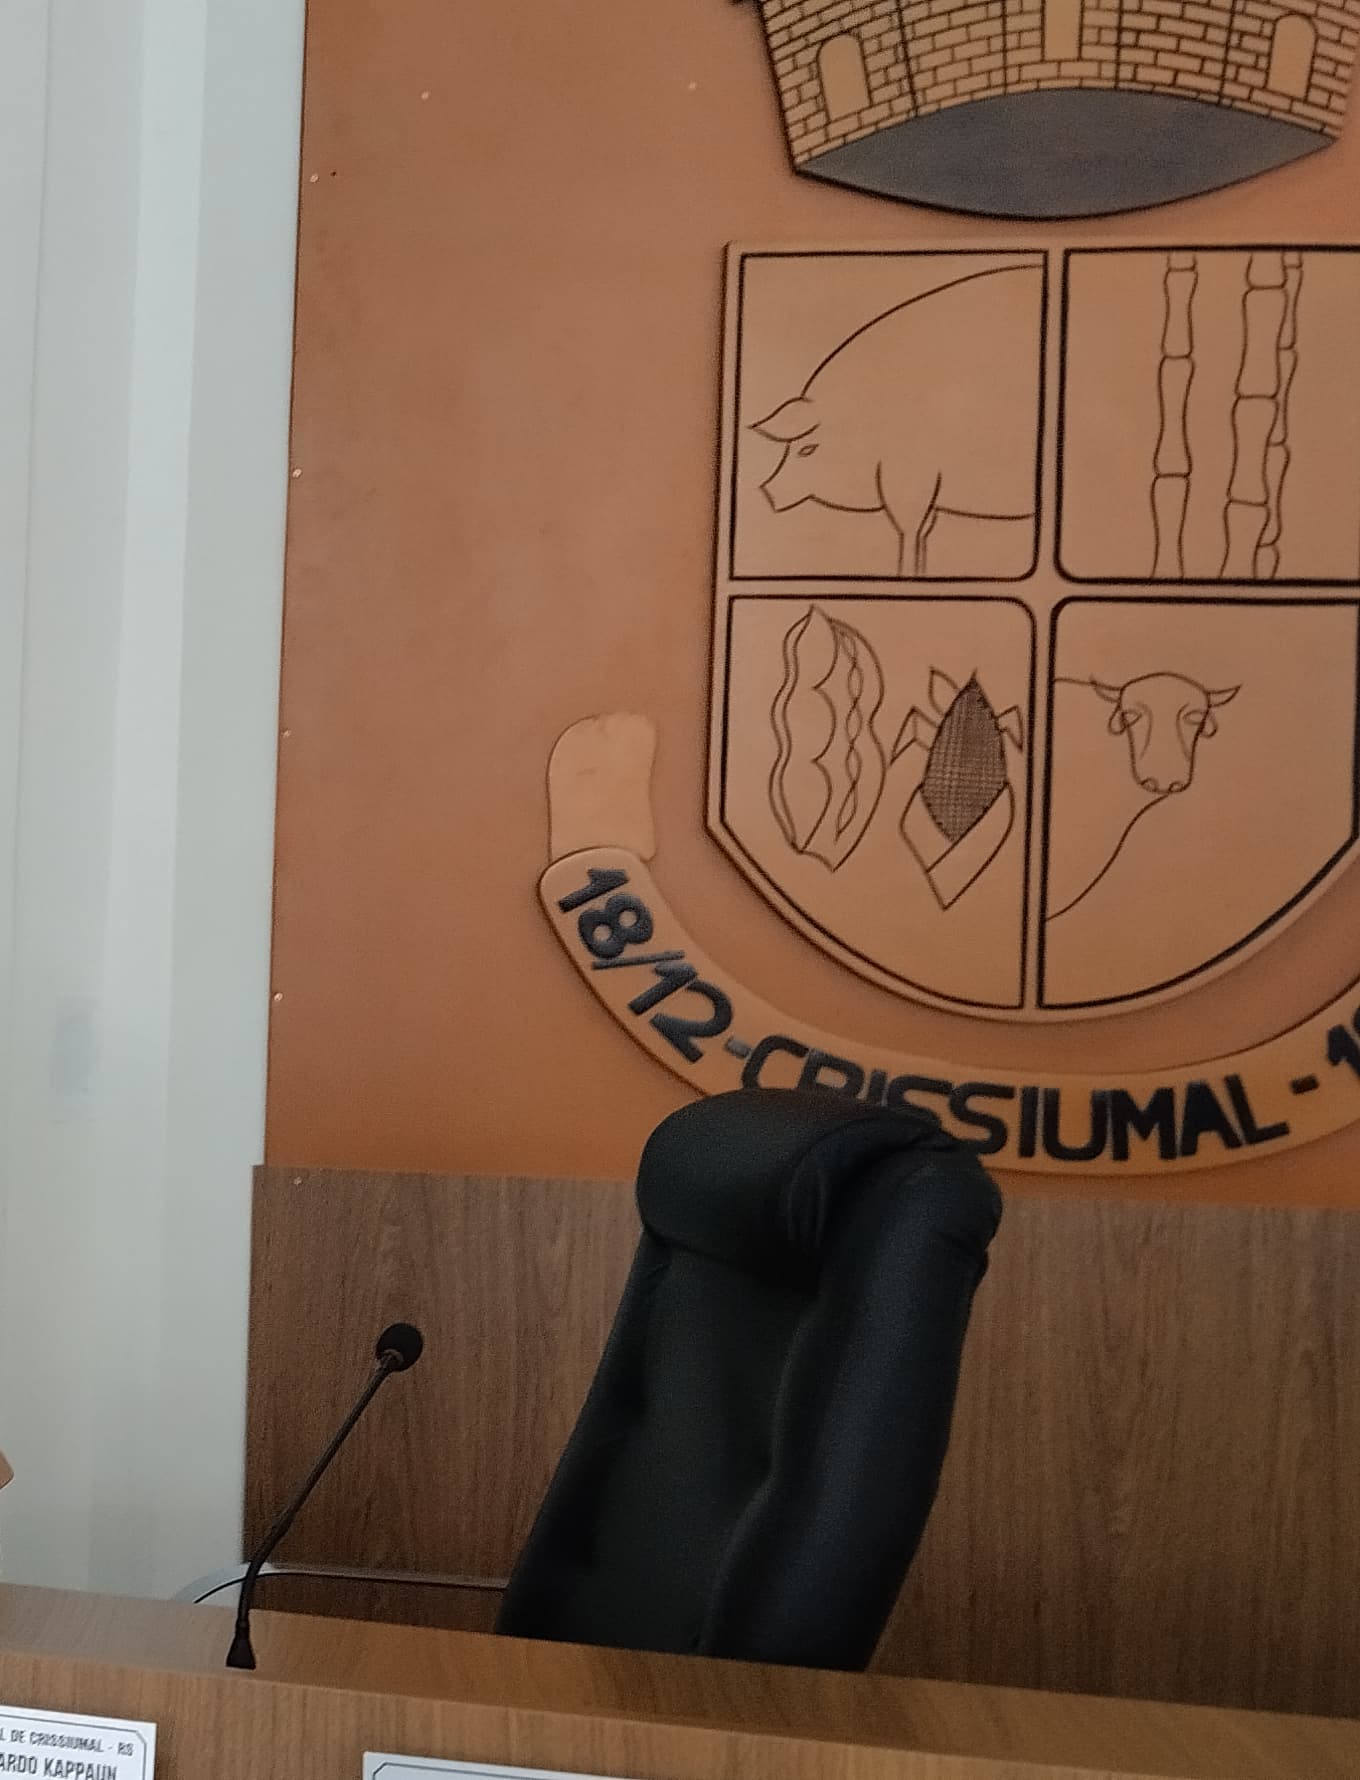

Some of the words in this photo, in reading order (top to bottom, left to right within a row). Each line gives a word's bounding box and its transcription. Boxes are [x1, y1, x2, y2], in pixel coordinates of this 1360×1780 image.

[10, 1729, 26, 1743] DE
[29, 1731, 104, 1753] CRISSIUMAL
[117, 1741, 134, 1757] RS
